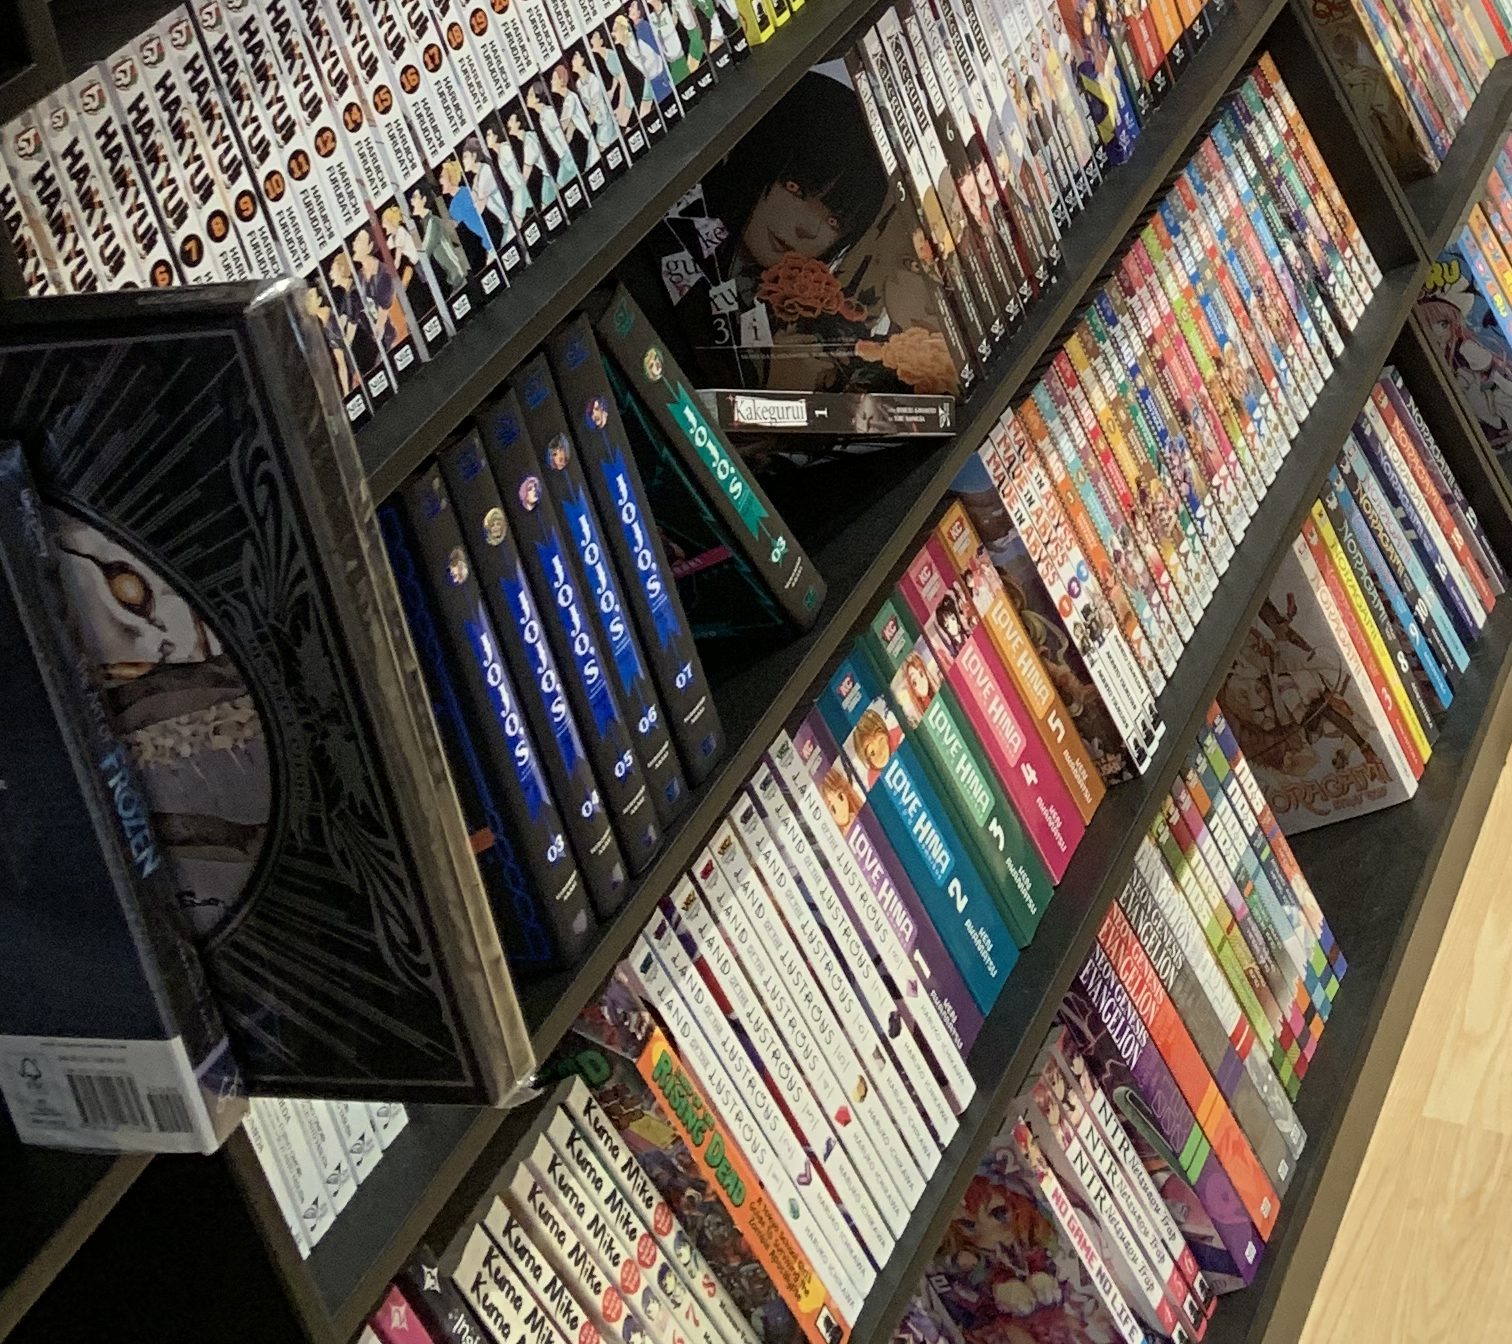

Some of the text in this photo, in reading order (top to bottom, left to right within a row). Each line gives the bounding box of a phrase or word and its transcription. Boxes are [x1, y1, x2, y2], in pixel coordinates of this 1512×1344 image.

[265, 174, 285, 198] 10
[666, 259, 697, 287] gu
[713, 318, 729, 346] 3
[734, 398, 807, 424] Kakegurui
[813, 407, 828, 418] 1
[682, 413, 744, 503] JOJO'S
[616, 472, 662, 600] JOJO'S
[770, 535, 787, 565] 03
[986, 453, 1059, 588] MADE IN ABYSS
[1338, 517, 1410, 674] NORAGAMI 8
[480, 631, 532, 770] JOJO'S
[675, 660, 695, 691] 07
[992, 600, 1067, 743] LOVE HINA 5
[100, 749, 162, 882] FROZEN
[546, 834, 566, 863] 03
[791, 772, 890, 944] LAND LUSTROUS
[884, 758, 970, 913] LOVE HINA 2
[963, 918, 998, 979] AKAMATSU
[979, 925, 994, 952] KEN
[1078, 959, 1144, 1071] EVANGELION
[1091, 943, 1150, 1044] NEON GENESIS
[583, 1097, 620, 1160] Kuma
[704, 1133, 747, 1208] DEAD
[1097, 1100, 1178, 1243] NTR Netsuzou Trap
[1052, 1188, 1140, 1339] NO GAME NO LIFE
